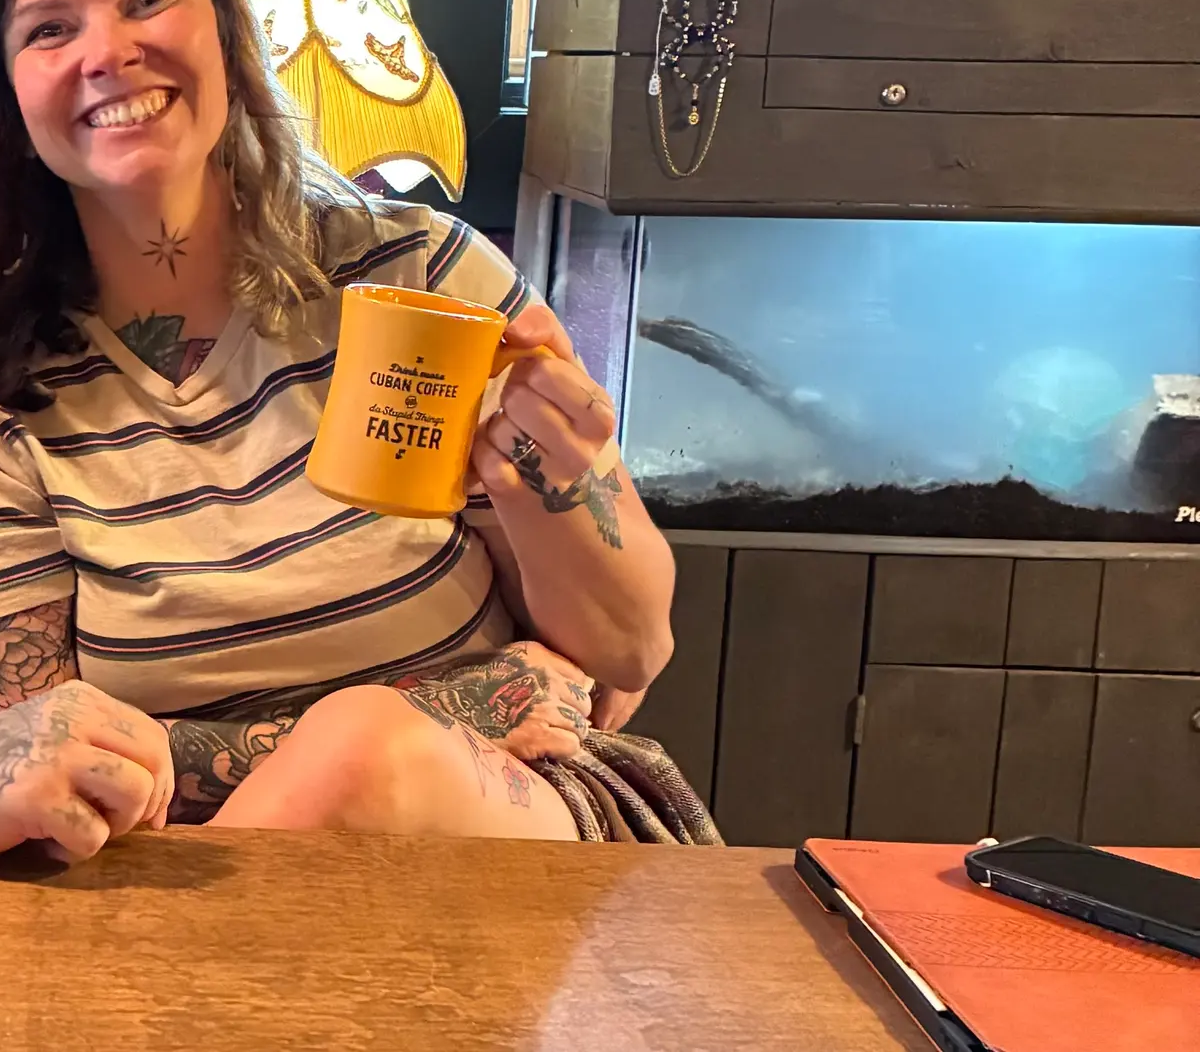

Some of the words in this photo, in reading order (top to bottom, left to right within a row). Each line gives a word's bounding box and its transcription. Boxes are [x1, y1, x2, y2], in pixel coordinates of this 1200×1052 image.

[388, 363, 418, 377] Drink
[370, 372, 412, 392] CUBAN
[416, 381, 459, 398] COFFEE
[369, 404, 381, 413] do
[382, 405, 414, 421] Stupid
[415, 411, 445, 426] Things
[366, 416, 444, 451] FASTER
